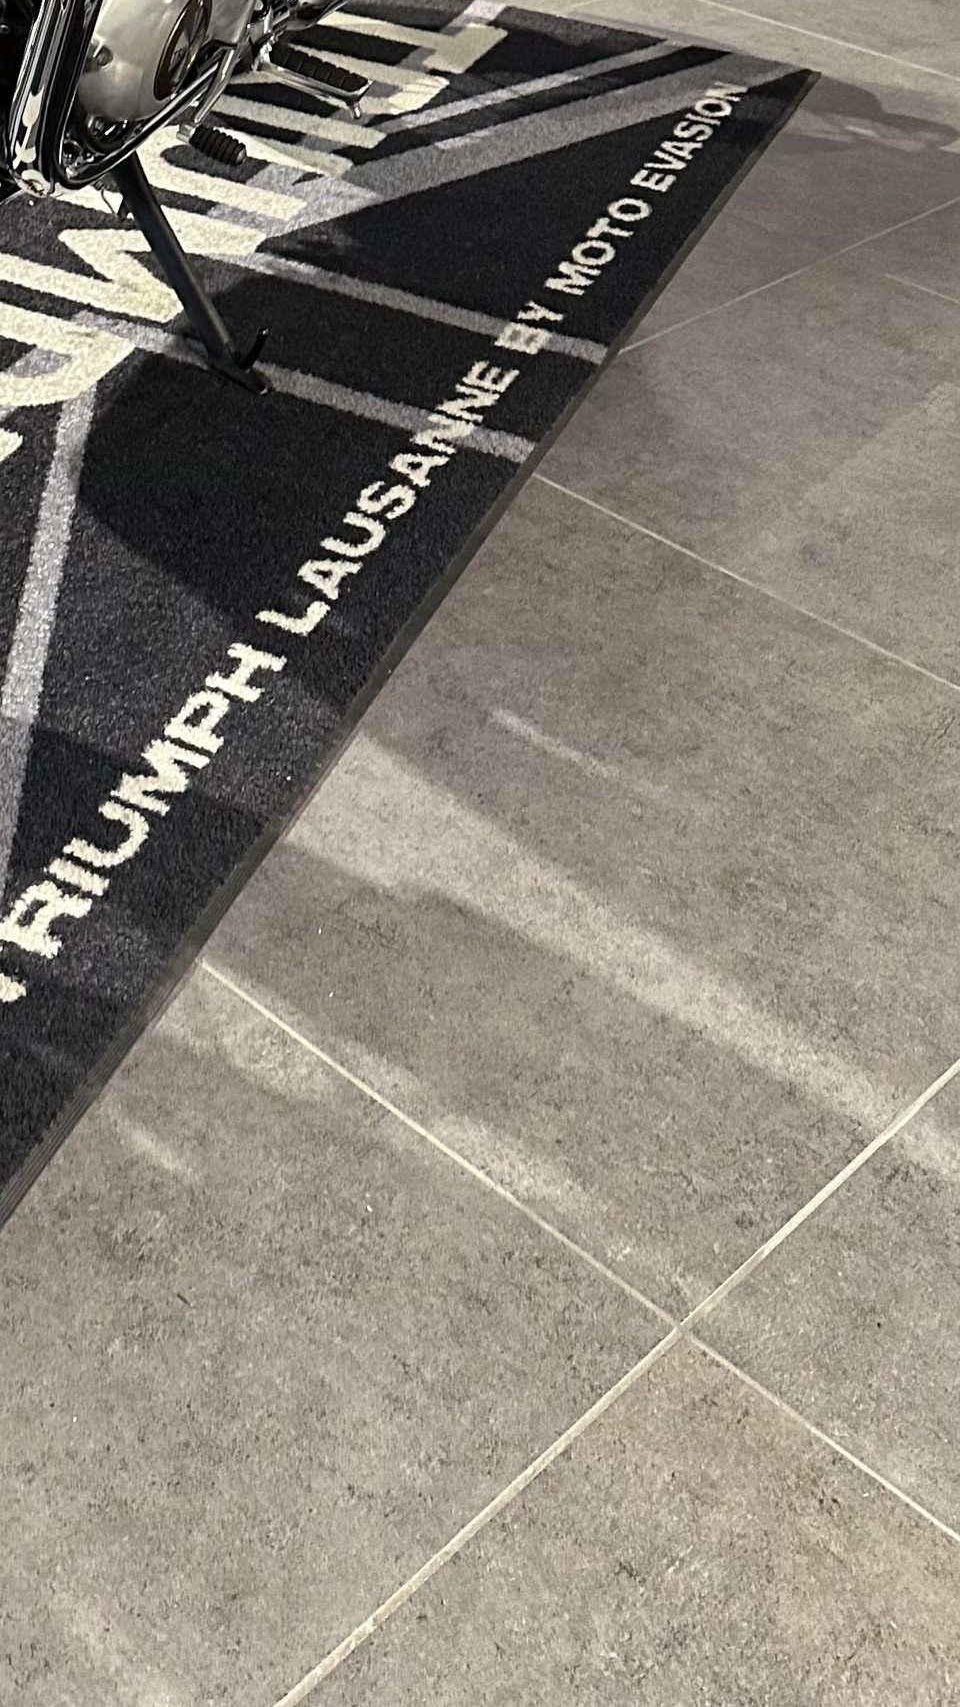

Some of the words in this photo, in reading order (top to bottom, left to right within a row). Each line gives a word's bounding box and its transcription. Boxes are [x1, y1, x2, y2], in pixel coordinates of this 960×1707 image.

[254, 360, 520, 636] LAUSANNE
[494, 300, 564, 355] BY
[544, 197, 653, 296] MOTO
[630, 81, 748, 192] EVASION
